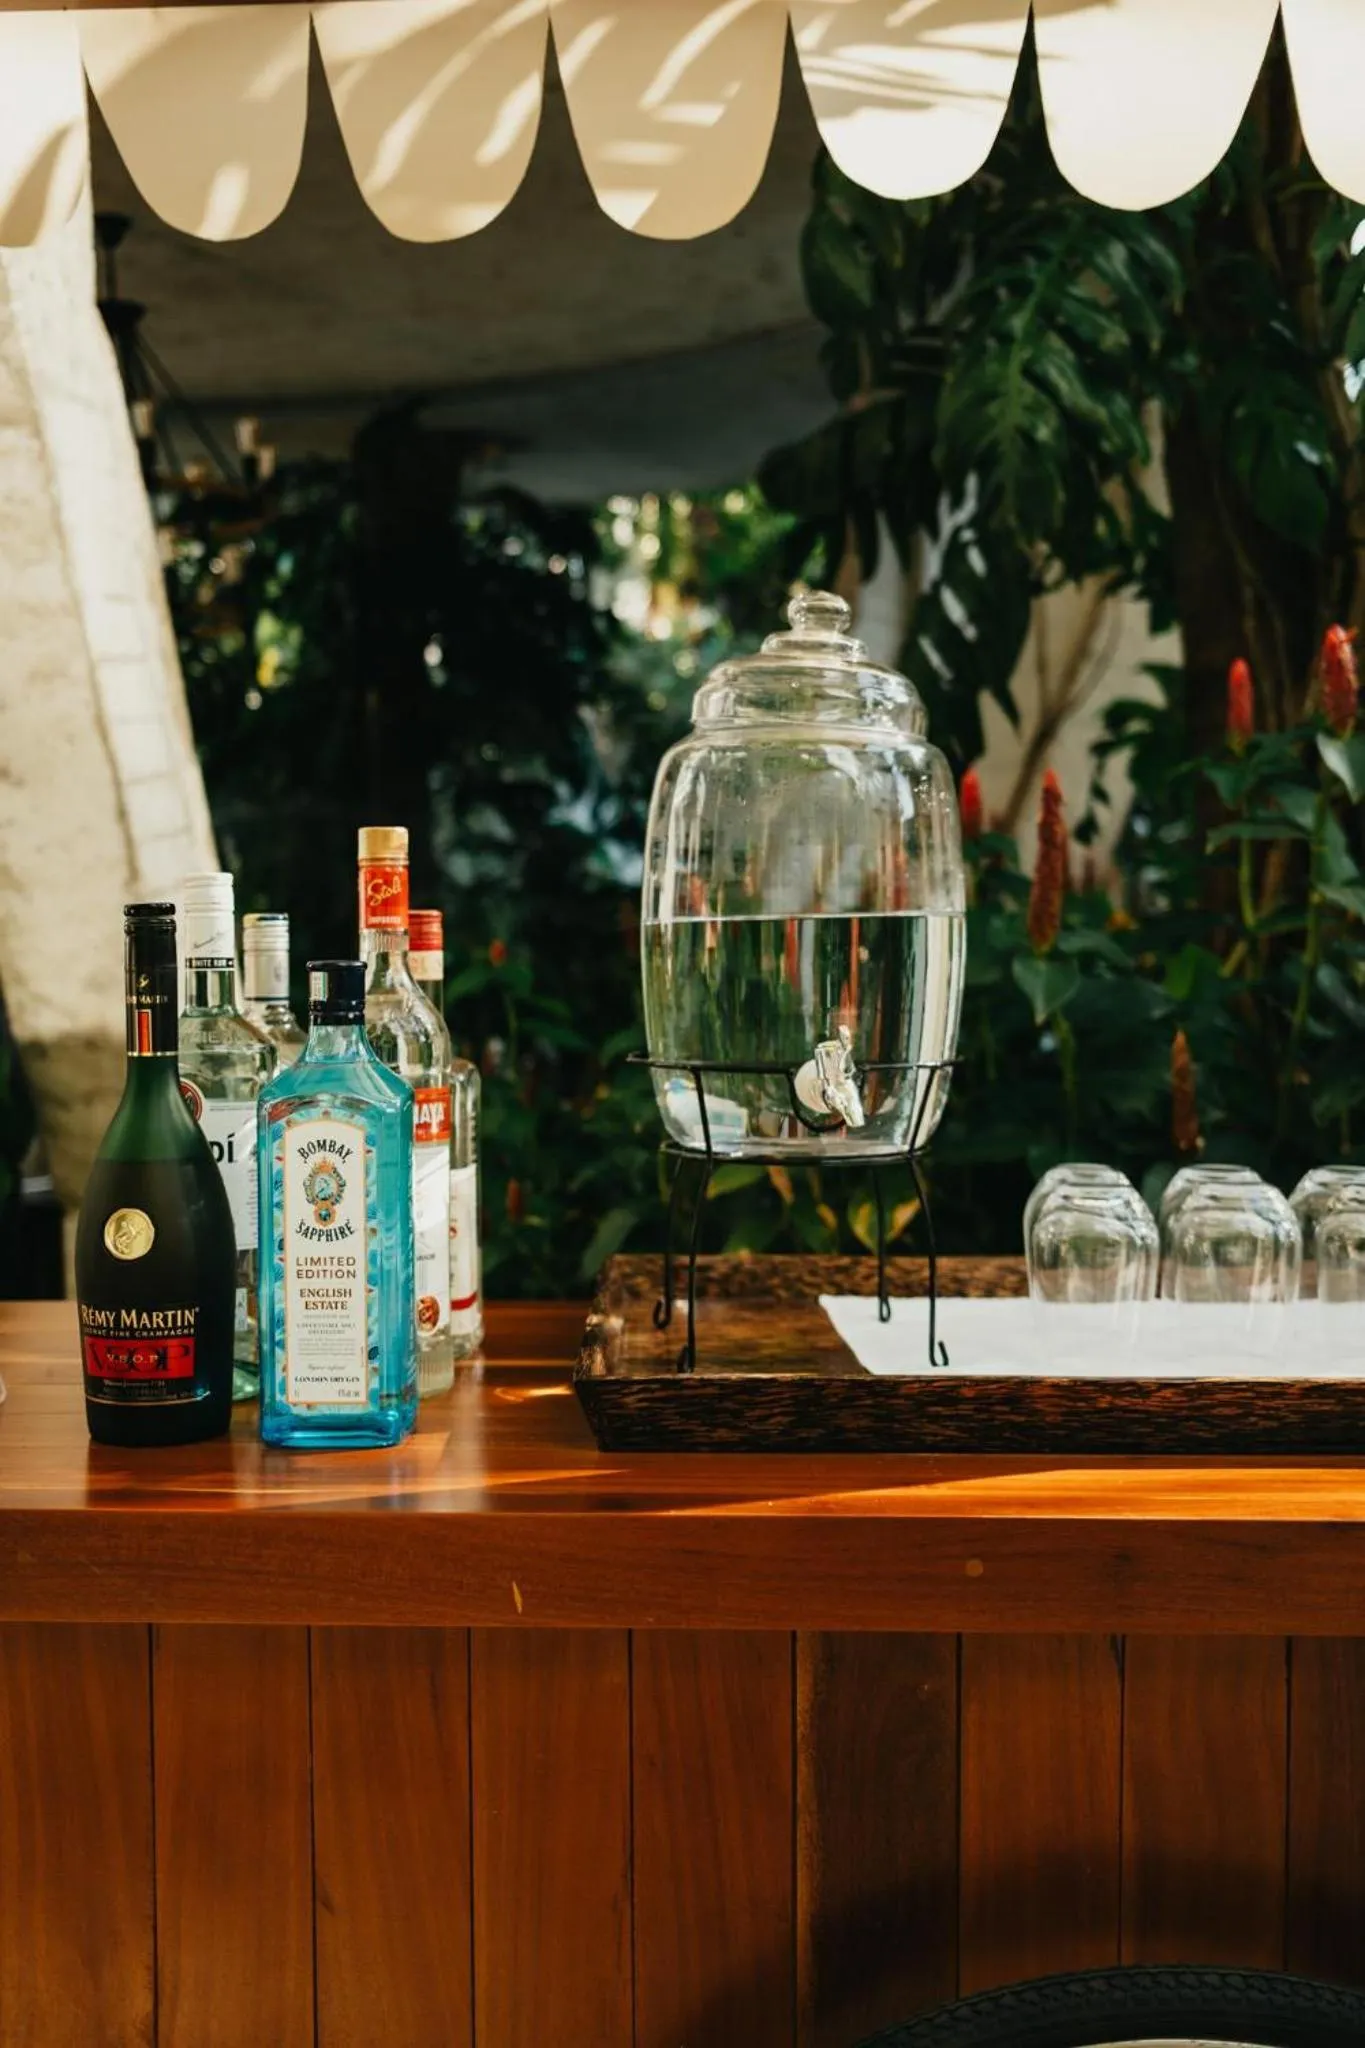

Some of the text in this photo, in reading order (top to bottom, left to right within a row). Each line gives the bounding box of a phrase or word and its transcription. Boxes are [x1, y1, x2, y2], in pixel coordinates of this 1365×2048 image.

[296, 1137, 354, 1163] BOMBAY
[294, 1218, 356, 1243] SAPPHIRE
[296, 1256, 356, 1267] LIMITED
[296, 1269, 356, 1280] EDITION
[299, 1287, 353, 1299] ENGLISH
[304, 1300, 349, 1311] ESTATE
[81, 1304, 116, 1328] RÉMY
